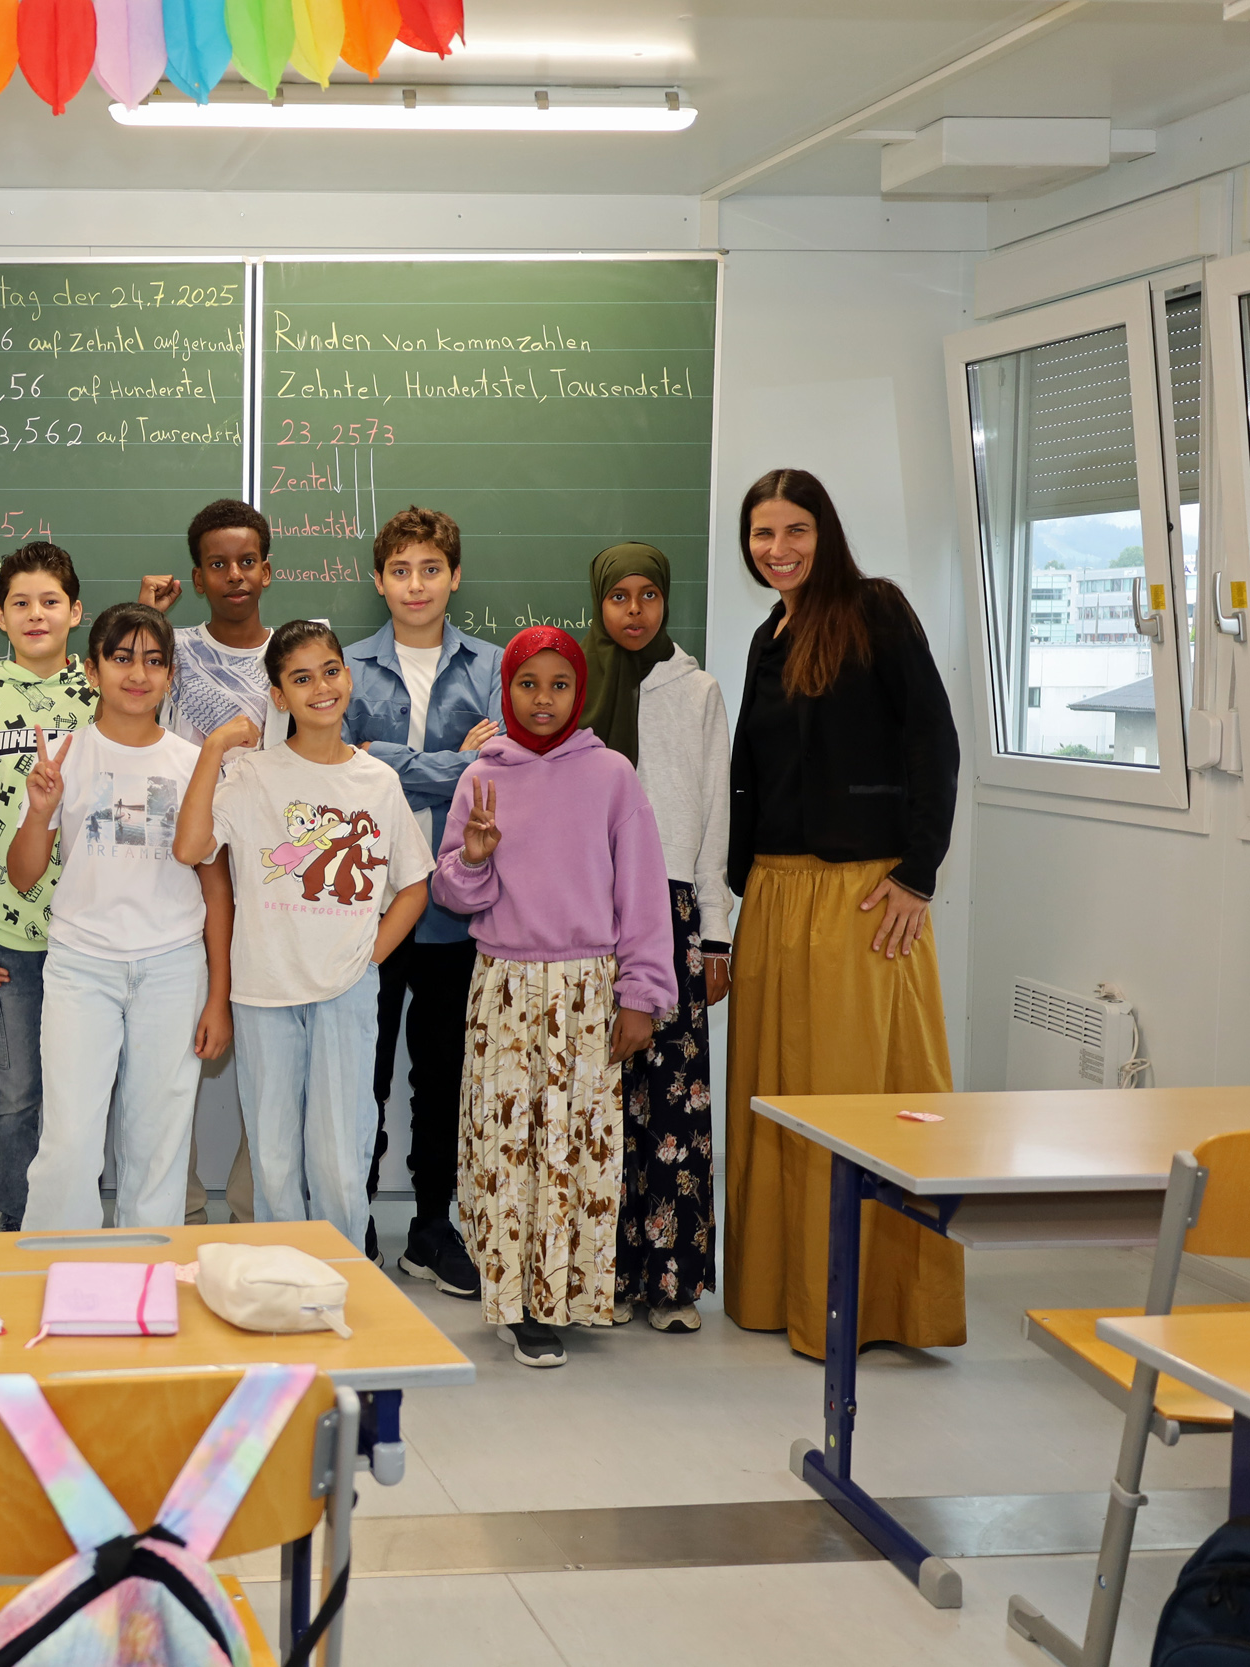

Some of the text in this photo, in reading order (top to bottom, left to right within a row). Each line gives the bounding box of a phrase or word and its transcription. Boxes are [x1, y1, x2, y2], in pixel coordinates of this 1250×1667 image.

[52, 278, 101, 306] der
[109, 281, 239, 310] 24.7.2025
[28, 330, 62, 359] auf
[274, 310, 371, 353] Runden
[67, 374, 101, 404] auf
[277, 365, 693, 406] Zehntel, Hundertstel, Tausendstel
[96, 420, 129, 452] auf
[276, 418, 395, 449] 23,2573
[269, 461, 333, 494] Zentel
[266, 554, 361, 583] ausendstel
[264, 901, 373, 917] BETTER TOGETHER
